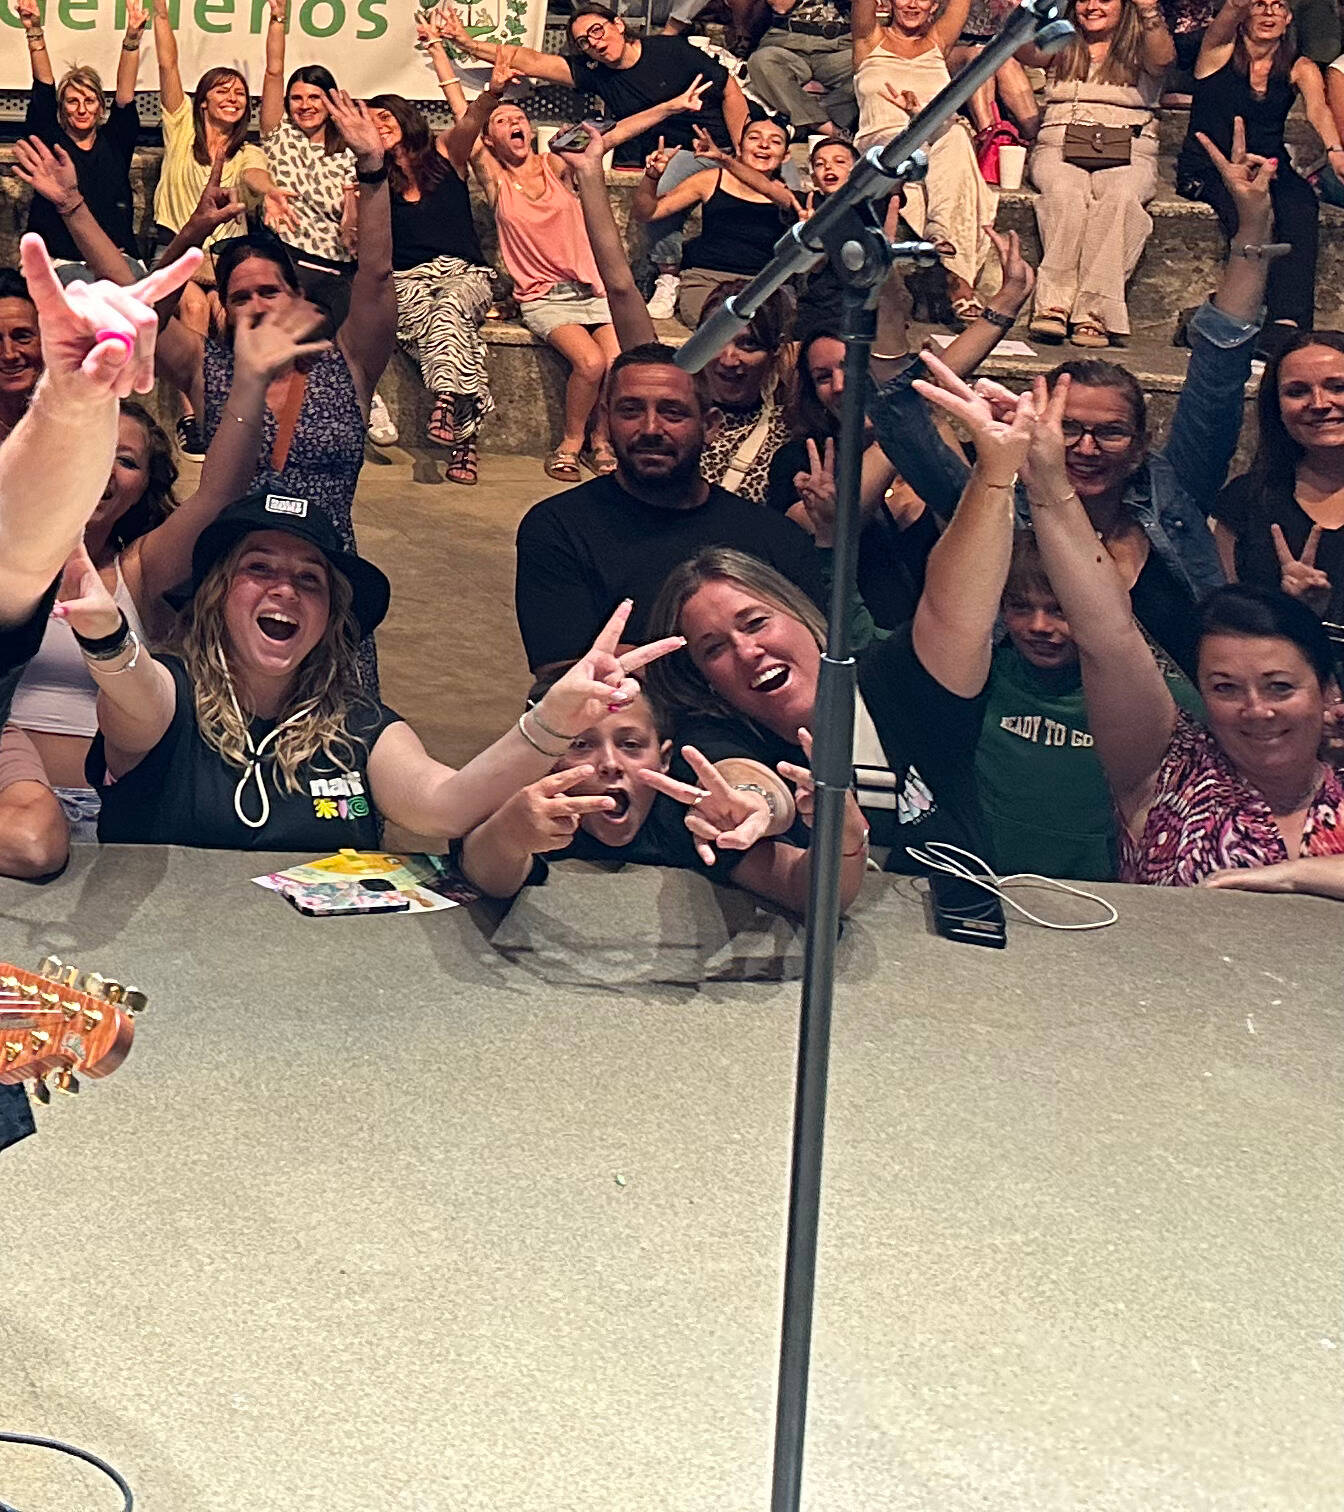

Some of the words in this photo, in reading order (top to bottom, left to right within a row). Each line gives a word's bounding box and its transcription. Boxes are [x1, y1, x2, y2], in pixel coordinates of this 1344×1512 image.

[1000, 716, 1042, 742] EADY
[1044, 718, 1067, 746] TO
[1071, 729, 1094, 747] GO
